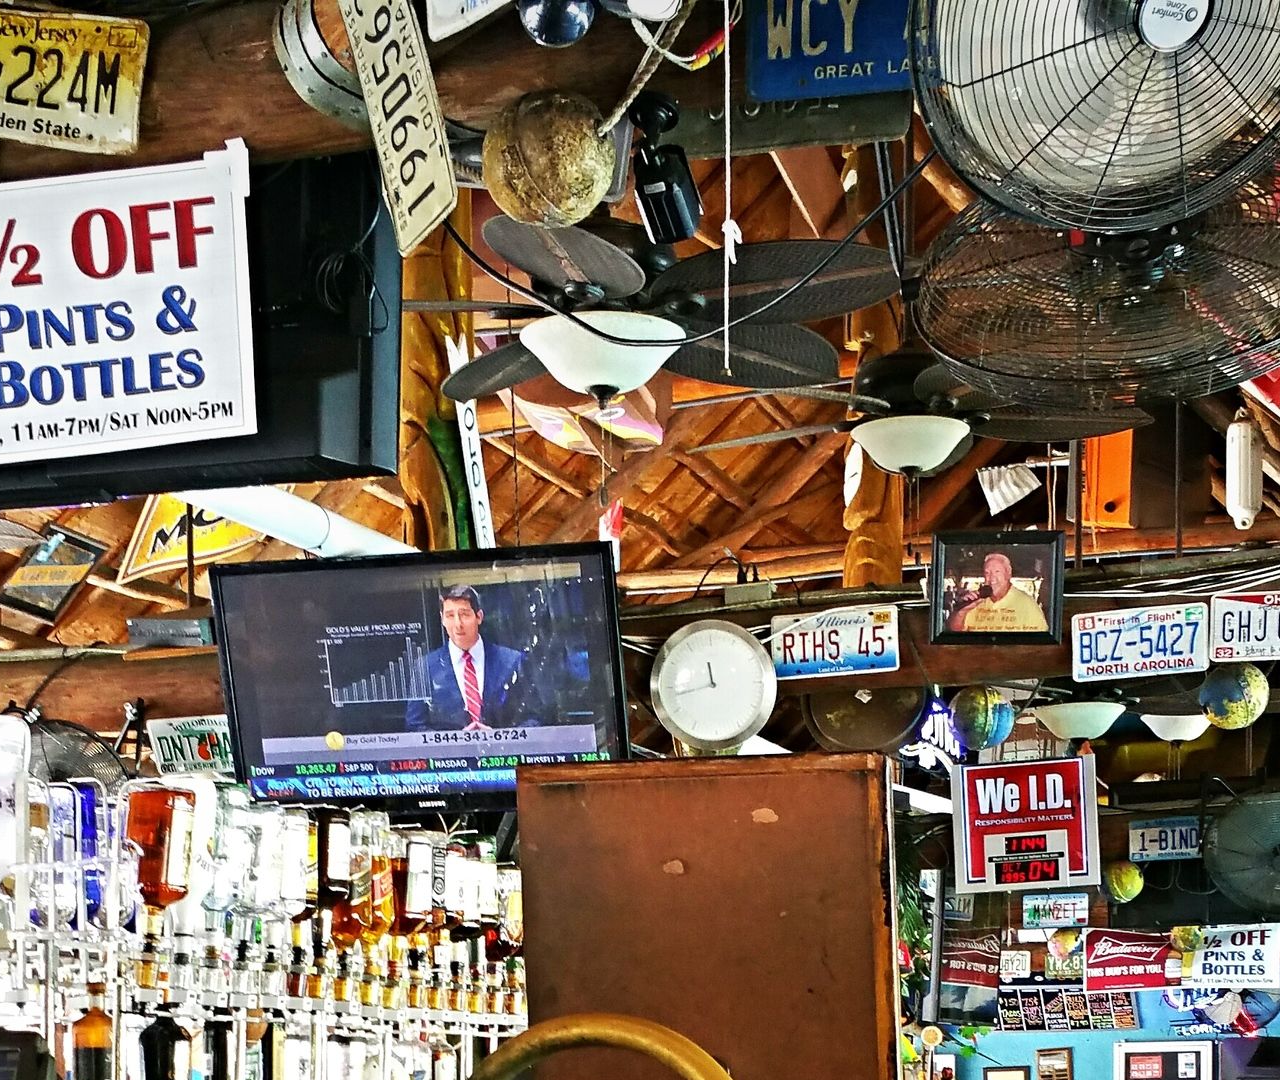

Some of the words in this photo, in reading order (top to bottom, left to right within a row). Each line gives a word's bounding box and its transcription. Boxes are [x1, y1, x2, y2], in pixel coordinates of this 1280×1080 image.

[1152, 7, 1183, 21] Comfort
[30, 19, 80, 44] Jersey
[394, 3, 438, 148] LOUISIANA
[814, 62, 874, 79] GREAT
[354, 0, 435, 216] 199D56
[32, 117, 80, 139] State
[71, 196, 215, 280] OFF
[156, 284, 199, 336] &
[816, 616, 866, 628] Illinois
[1103, 617, 1125, 626] First
[1147, 612, 1176, 624] Flight
[1222, 610, 1267, 643] GHJ
[783, 630, 840, 664] RIHS
[858, 626, 885, 657] 45
[1080, 622, 1200, 663] BCZ-5427
[1087, 663, 1129, 676] NORTH
[1134, 658, 1194, 672] CAROLINA
[422, 729, 528, 743] 1-844-341-6724
[256, 767, 275, 776] DOW
[434, 760, 468, 769] NASDAQ
[308, 789, 320, 798] TO
[321, 788, 333, 797] BE
[379, 783, 440, 794] CITIBANAMEX
[976, 778, 1020, 815] We
[1028, 773, 1072, 811] I.D.
[1028, 861, 1056, 881] 04
[1231, 929, 1272, 946] OFF
[1094, 940, 1158, 956] Budweiser
[1253, 948, 1264, 961] &
[1087, 968, 1105, 977] THIS
[1129, 965, 1144, 974] FOR
[1145, 964, 1164, 974] YOU.
